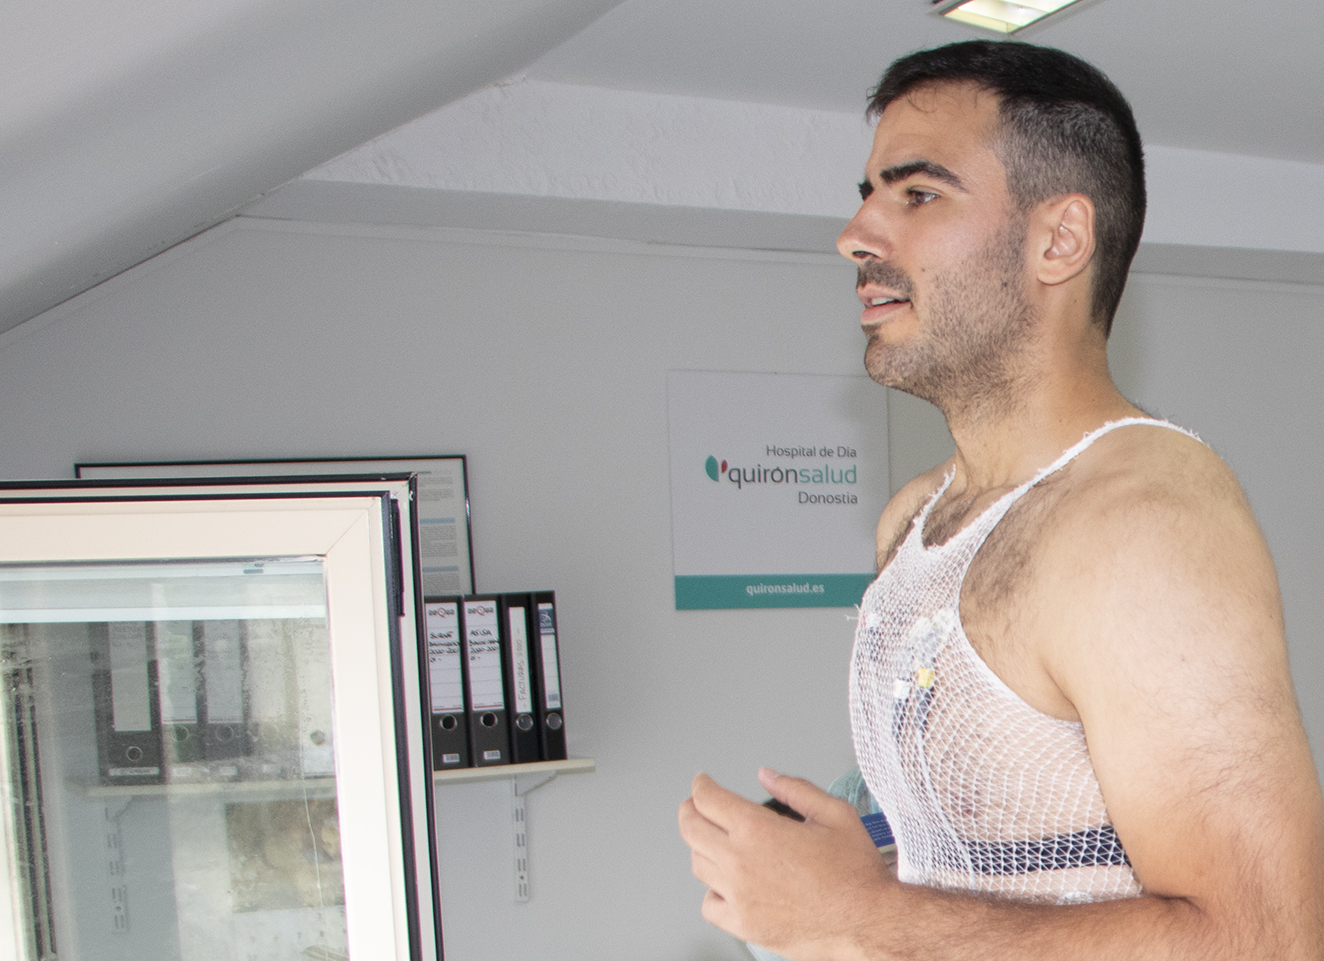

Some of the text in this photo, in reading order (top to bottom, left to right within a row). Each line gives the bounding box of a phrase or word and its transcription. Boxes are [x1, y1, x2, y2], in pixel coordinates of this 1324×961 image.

[766, 445, 816, 459] Hospital
[819, 446, 834, 457] de
[728, 464, 857, 489] quirónsalud
[798, 491, 858, 504] Donostia
[746, 583, 825, 595] quironsalud.es
